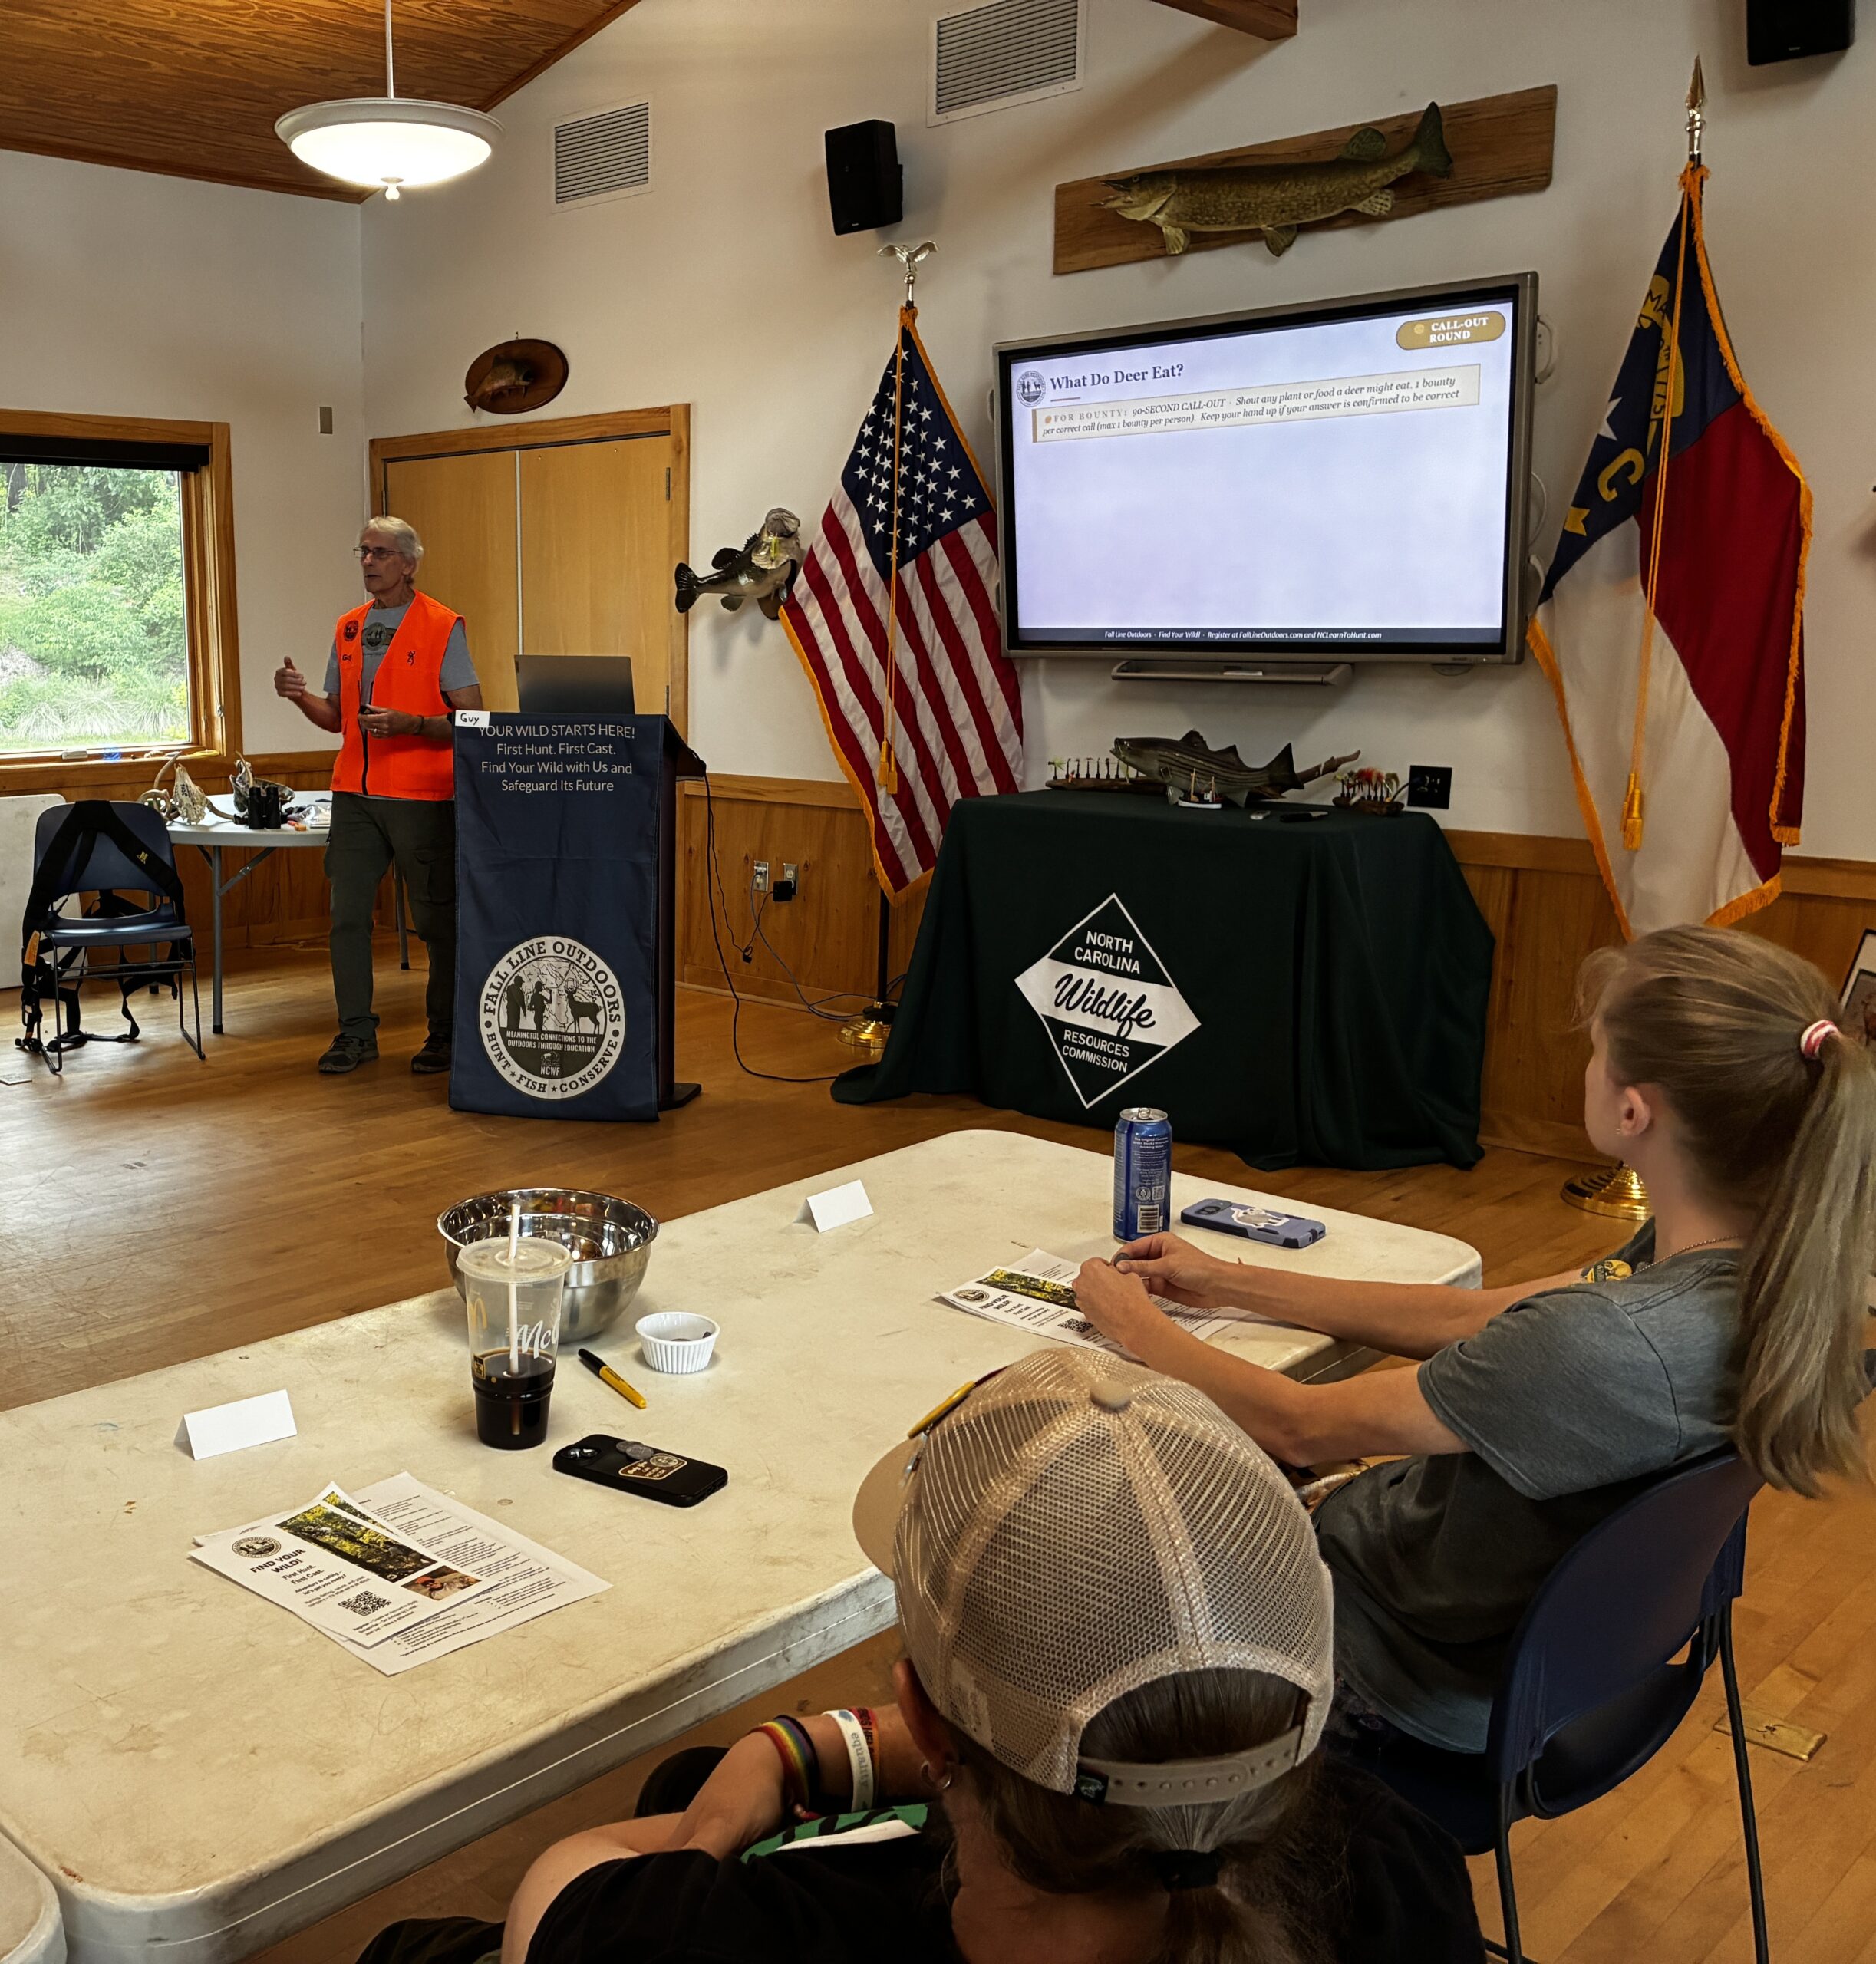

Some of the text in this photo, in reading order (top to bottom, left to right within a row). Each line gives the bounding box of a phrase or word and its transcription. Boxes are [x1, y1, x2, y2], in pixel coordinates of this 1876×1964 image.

[1431, 318, 1489, 331] CALL-OUT
[1429, 331, 1470, 343] ROUND
[1050, 364, 1184, 390] What Do Deer Eat?
[1054, 414, 1074, 423] FOR
[1080, 409, 1127, 420] BOUNTY:
[1133, 404, 1180, 417] 90-SECOND
[1182, 399, 1226, 410] CALL-OUT
[1236, 396, 1259, 406] Shout
[1261, 395, 1277, 404] any
[1278, 392, 1301, 404] plant
[1304, 391, 1314, 400] or
[1314, 387, 1335, 400] food
[1344, 386, 1365, 395] deer
[1367, 382, 1393, 394] might
[1396, 382, 1413, 390] eat.
[1422, 377, 1456, 387] bounty
[1043, 428, 1054, 437] per
[1056, 425, 1081, 434] correct
[1082, 422, 1096, 431] call
[1096, 422, 1116, 431] (max
[1123, 418, 1149, 428] bounty
[1150, 419, 1163, 427] per
[1201, 413, 1220, 422] Keep
[1222, 410, 1241, 421] your
[1243, 407, 1264, 417] hand
[1266, 407, 1277, 417] up
[1278, 405, 1287, 416] if
[1286, 405, 1307, 415] your
[1308, 403, 1342, 412] answer
[1344, 399, 1350, 408] is
[1353, 394, 1399, 408] confirmed
[1400, 395, 1410, 404] to
[1413, 393, 1424, 402] be
[1425, 390, 1459, 400] correct
[1598, 448, 1645, 502] C
[1207, 631, 1230, 640] Register
[460, 713, 479, 725] Guy
[479, 724, 635, 739] YOUR WILD STARTS HERE!
[497, 743, 616, 755] First Hunt. First Cast.
[481, 761, 632, 774] Find Your Wild with Us and
[501, 779, 615, 794] Safeguard Its Future
[1086, 931, 1133, 954] NORTH
[1074, 947, 1141, 974] CAROLINA
[484, 941, 621, 1023] FALL LINE OUTDOORS
[1054, 973, 1156, 1039] Wildlife
[506, 1030, 539, 1040] MEANINGFUL
[540, 1033, 576, 1043] CONNECTIONS
[1063, 1029, 1130, 1058] RESOURCES
[507, 1040, 595, 1053] OUTDOORS THROUGH EDUCATION
[486, 1033, 618, 1093] HUNT FISH CONSERVE
[1062, 1045, 1128, 1073] COMMISSION
[540, 1066, 561, 1076] NCWF
[249, 1549, 307, 1574] FIND YOUR
[270, 1558, 304, 1574] WILD!
[282, 1564, 317, 1580] First Hunt.
[291, 1575, 308, 1586] First
[851, 1732, 871, 1788] equality
